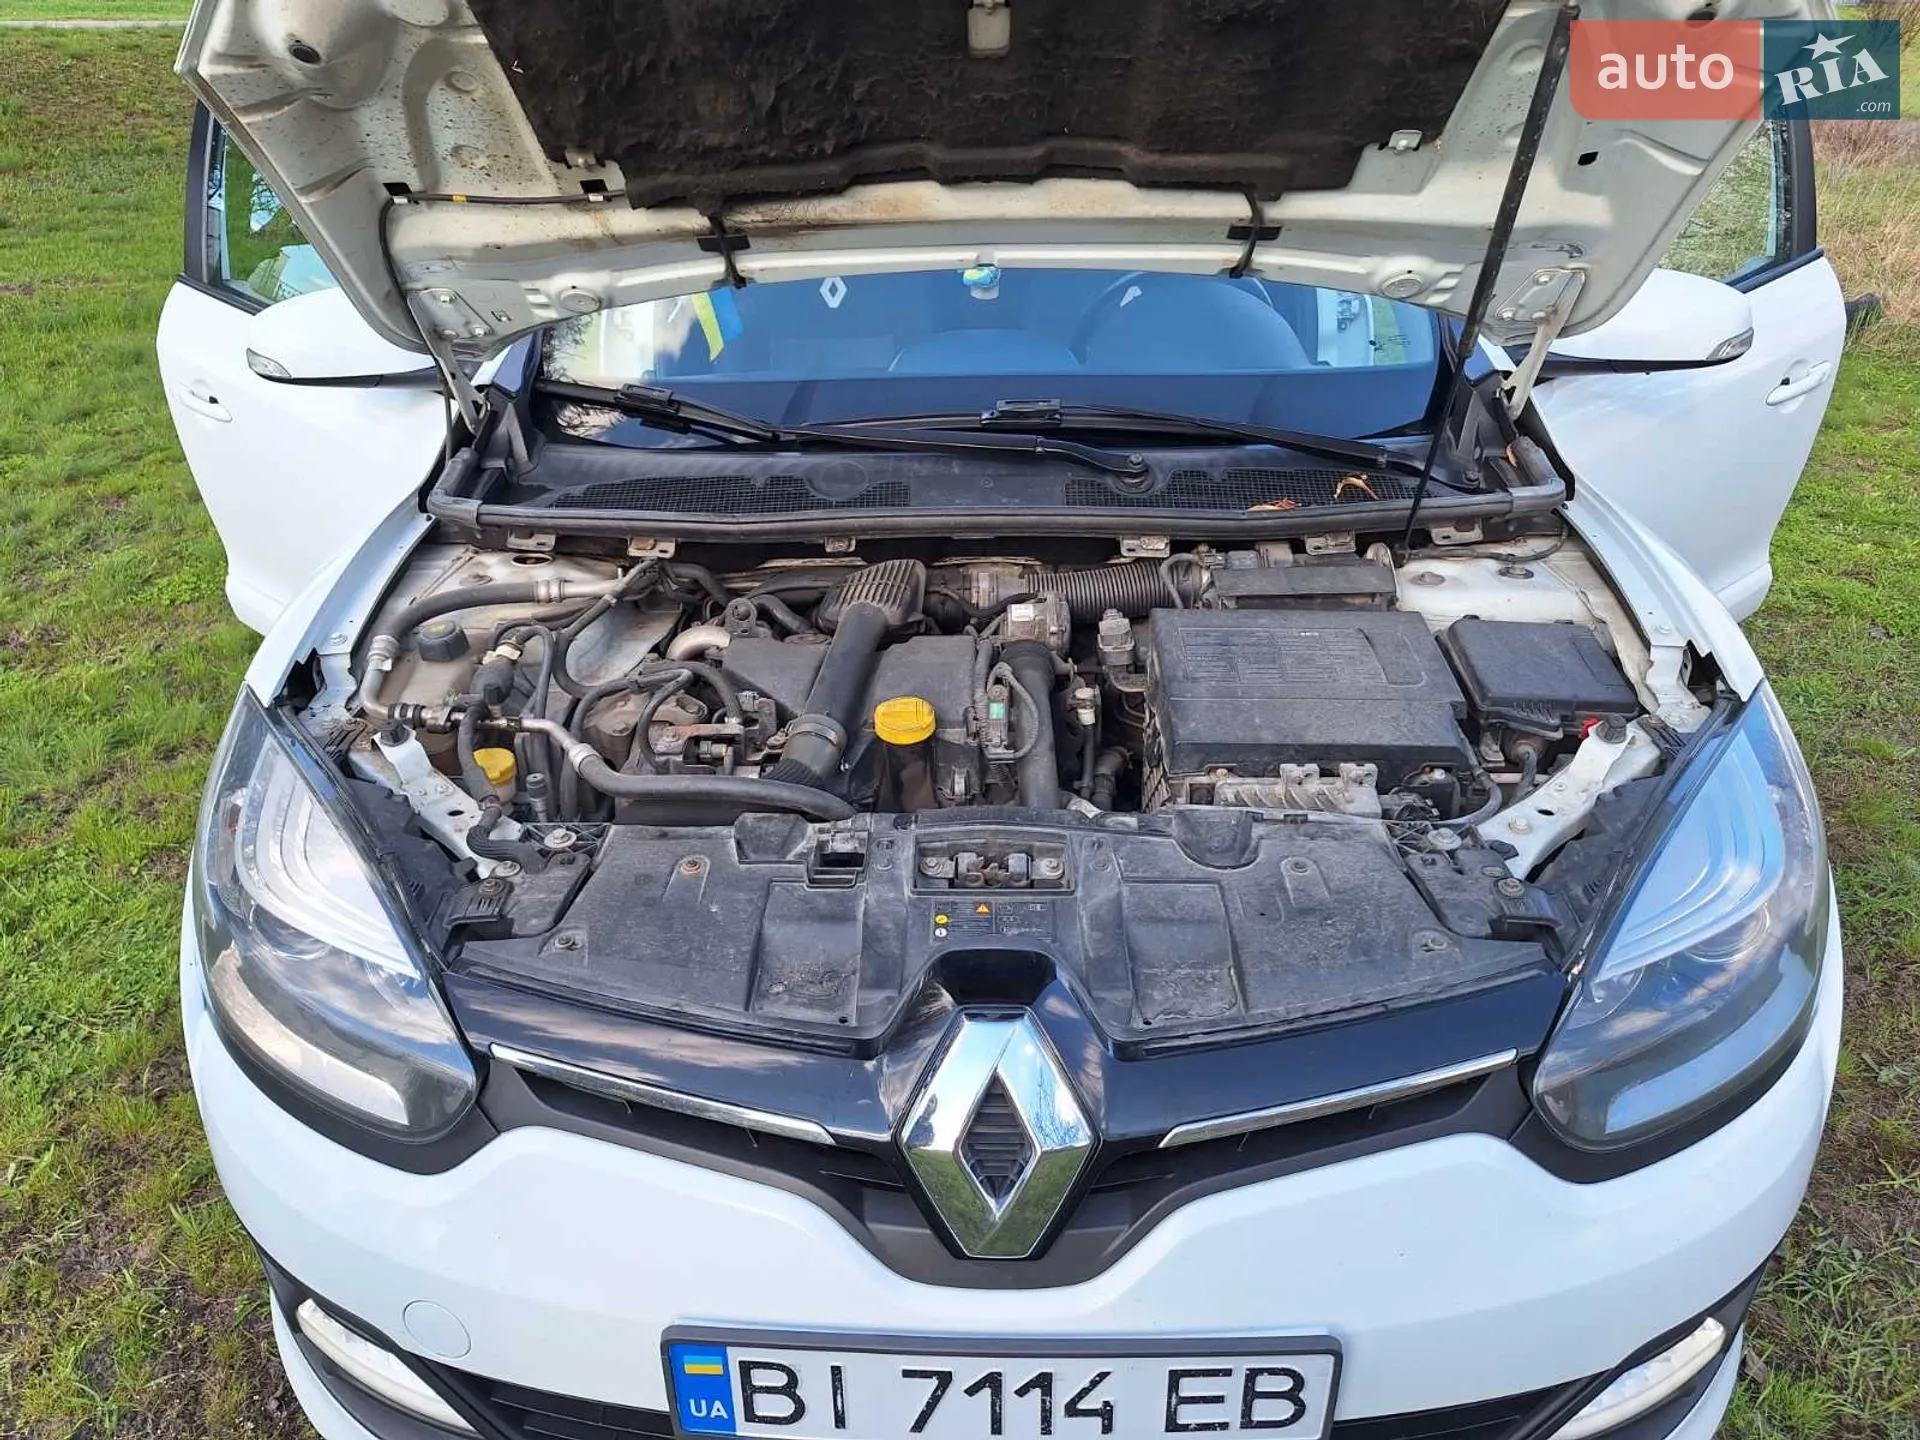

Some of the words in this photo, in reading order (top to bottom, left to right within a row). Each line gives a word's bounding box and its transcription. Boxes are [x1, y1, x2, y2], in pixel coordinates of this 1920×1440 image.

[689, 1398, 729, 1420] UA
[738, 1360, 847, 1429] BI
[901, 1367, 1114, 1435] 7114
[1164, 1367, 1307, 1432] EB
